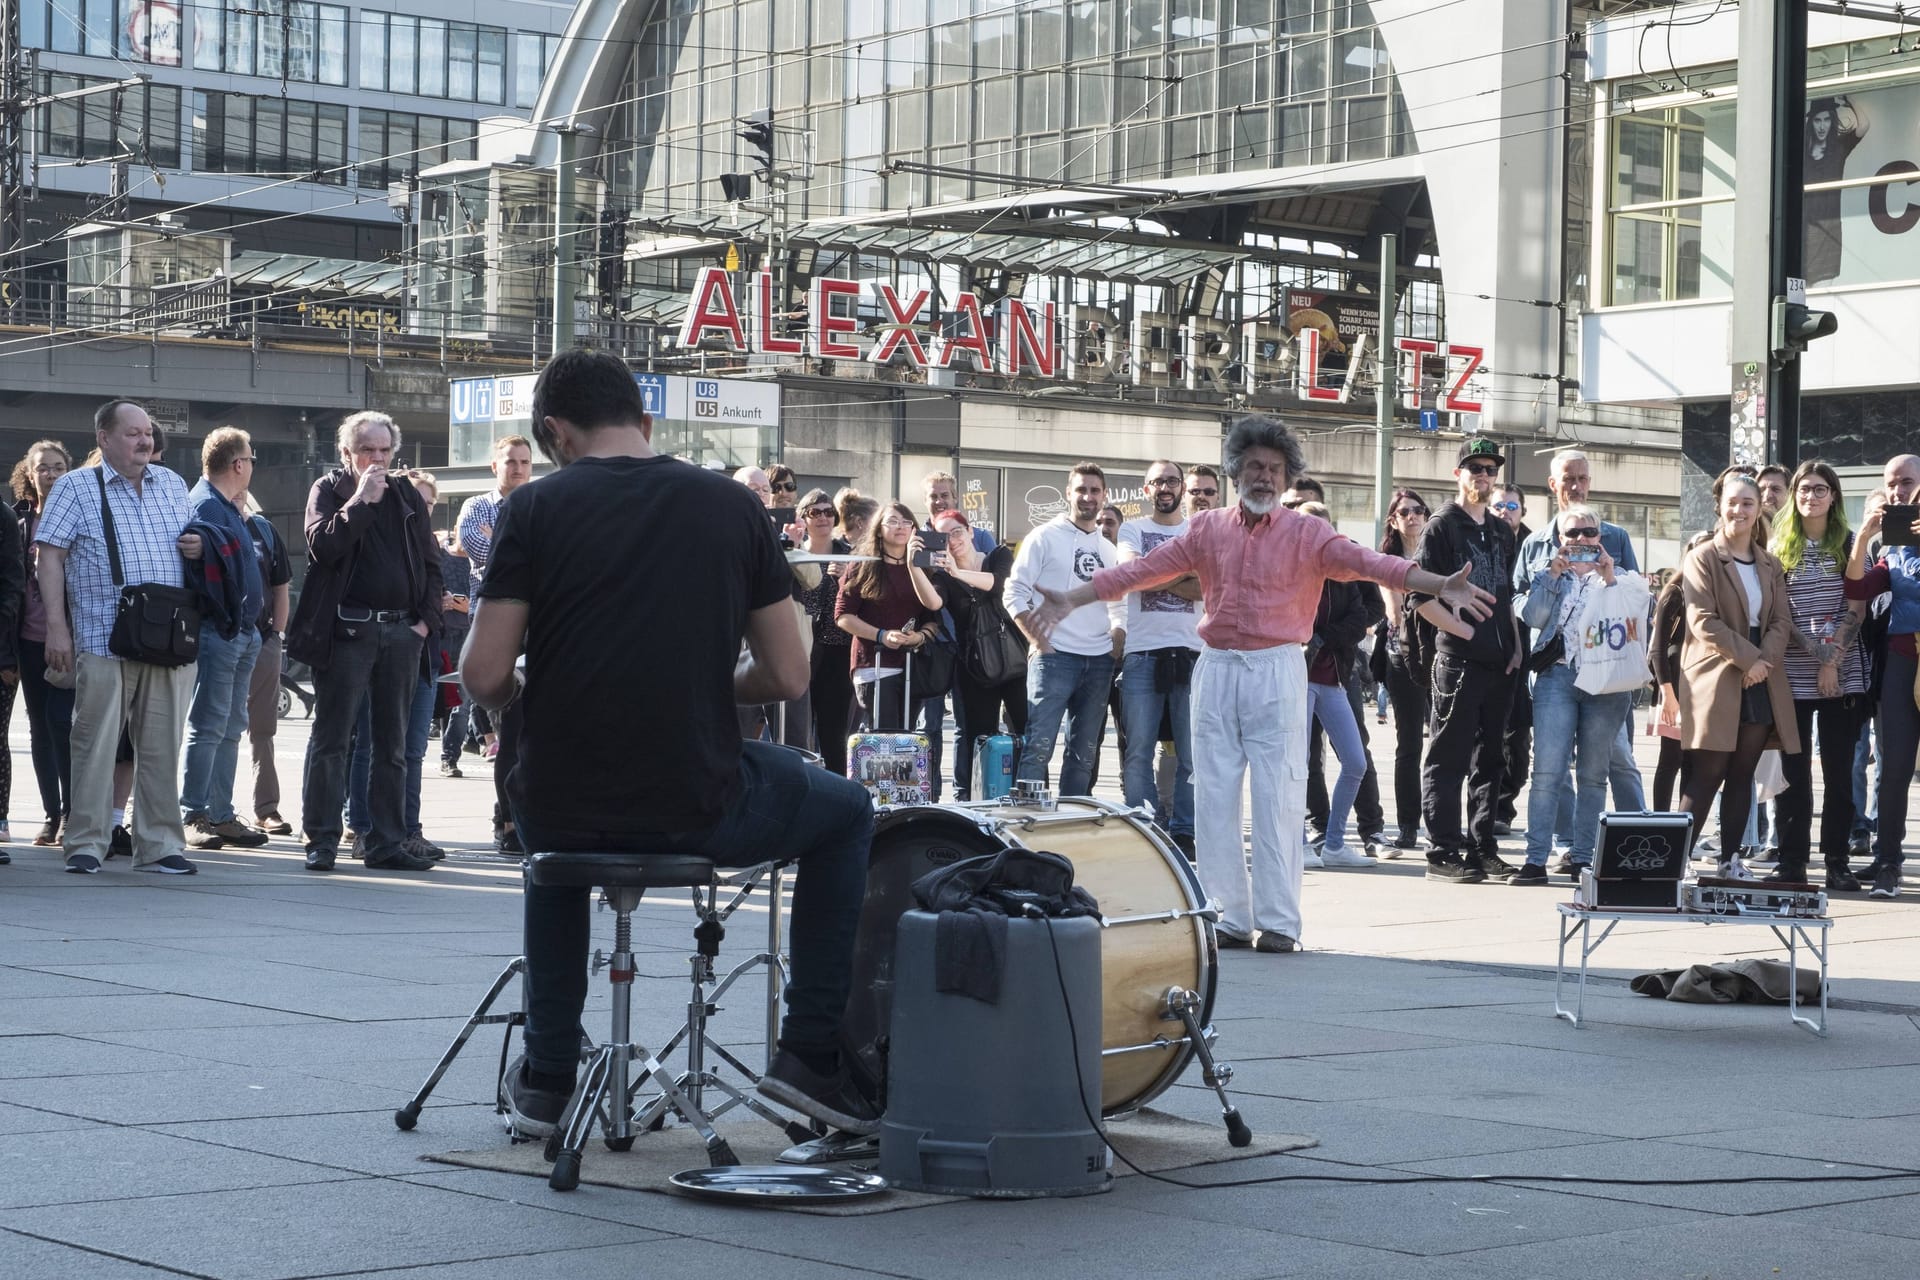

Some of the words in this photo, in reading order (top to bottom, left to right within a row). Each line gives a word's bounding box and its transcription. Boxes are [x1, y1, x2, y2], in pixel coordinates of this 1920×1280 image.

[1790, 279, 1803, 291] 234
[1291, 295, 1311, 307] NEU
[1340, 308, 1359, 316] WENN
[1359, 310, 1379, 318] SCHON
[1339, 316, 1363, 325] SCHARF,
[502, 382, 513, 395] U8
[698, 383, 717, 397] U8
[454, 383, 471, 421] U
[501, 401, 513, 415] U5
[698, 402, 717, 416] U5
[722, 405, 762, 419] Ankunft
[966, 479, 982, 492] HIER
[968, 510, 978, 522] DU
[1617, 859, 1666, 868] AKG
